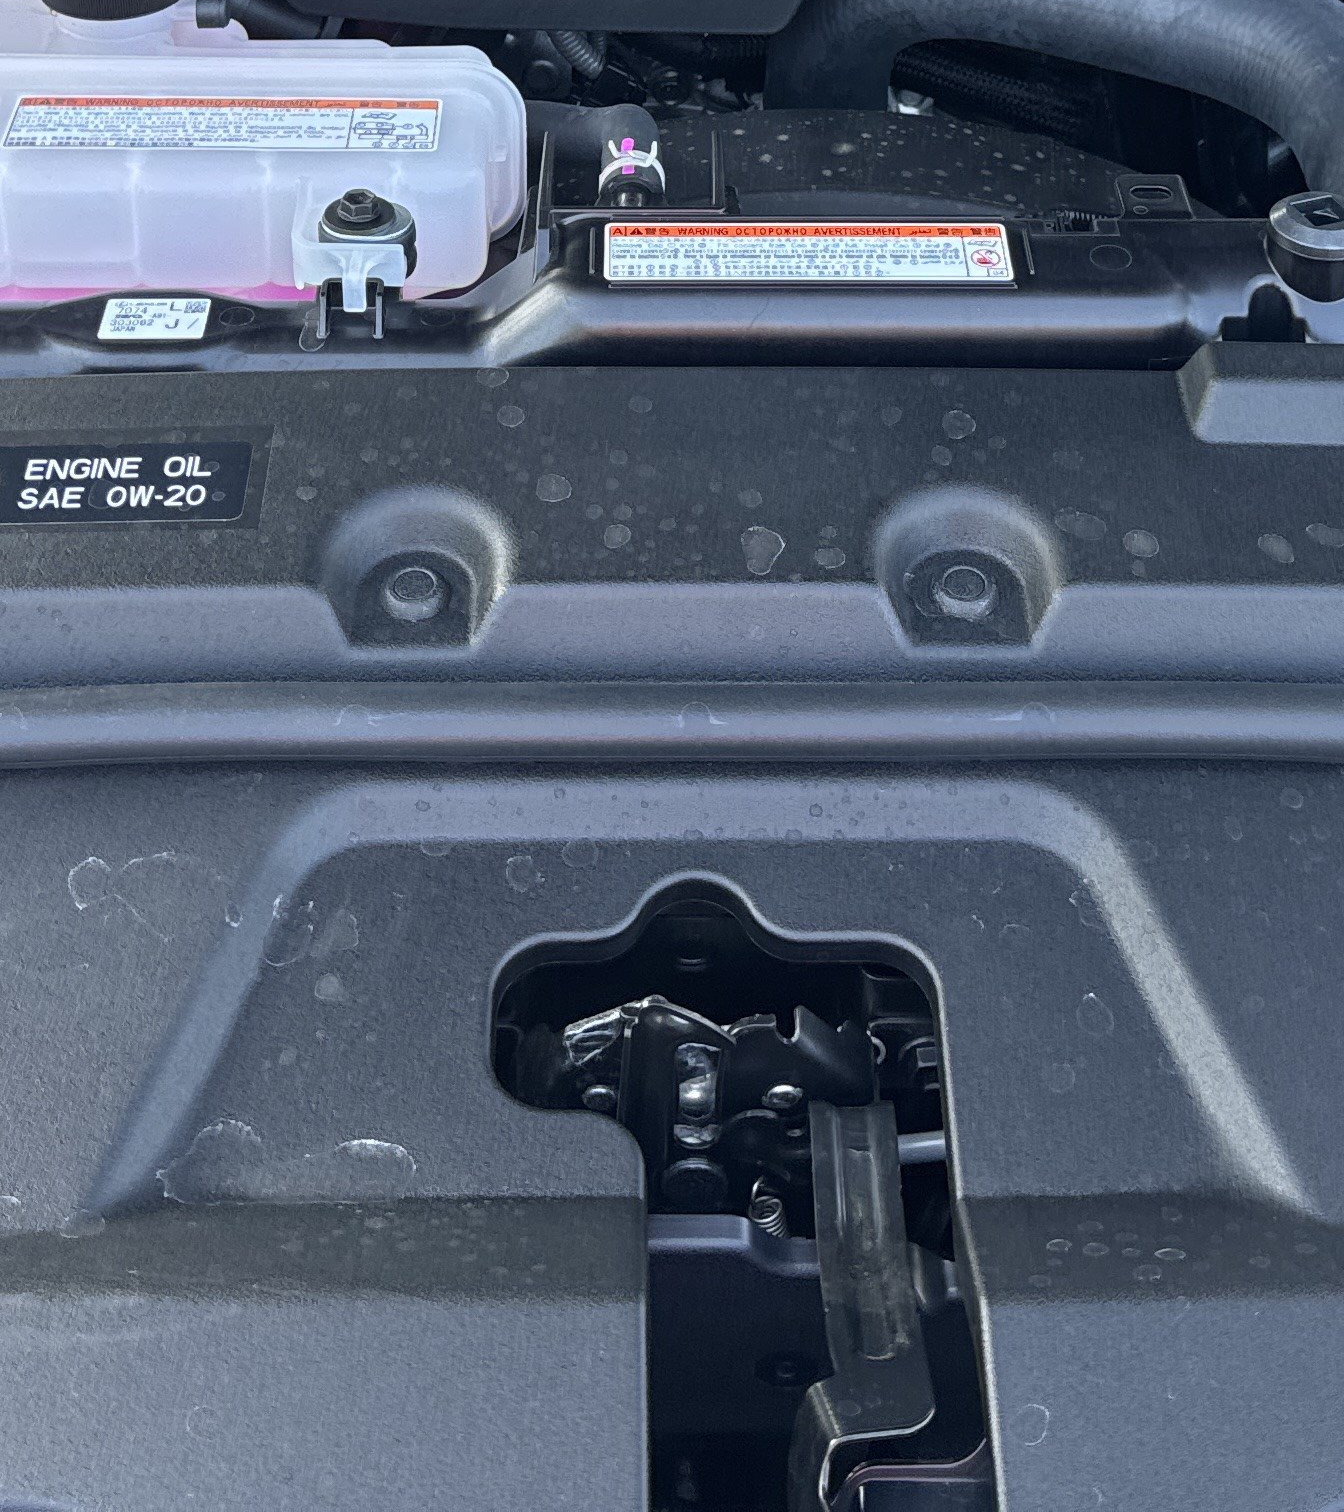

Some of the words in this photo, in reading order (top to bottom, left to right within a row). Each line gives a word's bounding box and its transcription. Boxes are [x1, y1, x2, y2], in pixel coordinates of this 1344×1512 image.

[677, 227, 729, 236] WARNING
[813, 227, 902, 236] AVERTISSEMENT
[23, 456, 143, 481] ENGINE
[162, 455, 212, 478] OIL
[16, 486, 85, 510] SAE
[105, 484, 208, 509] 0W-20
